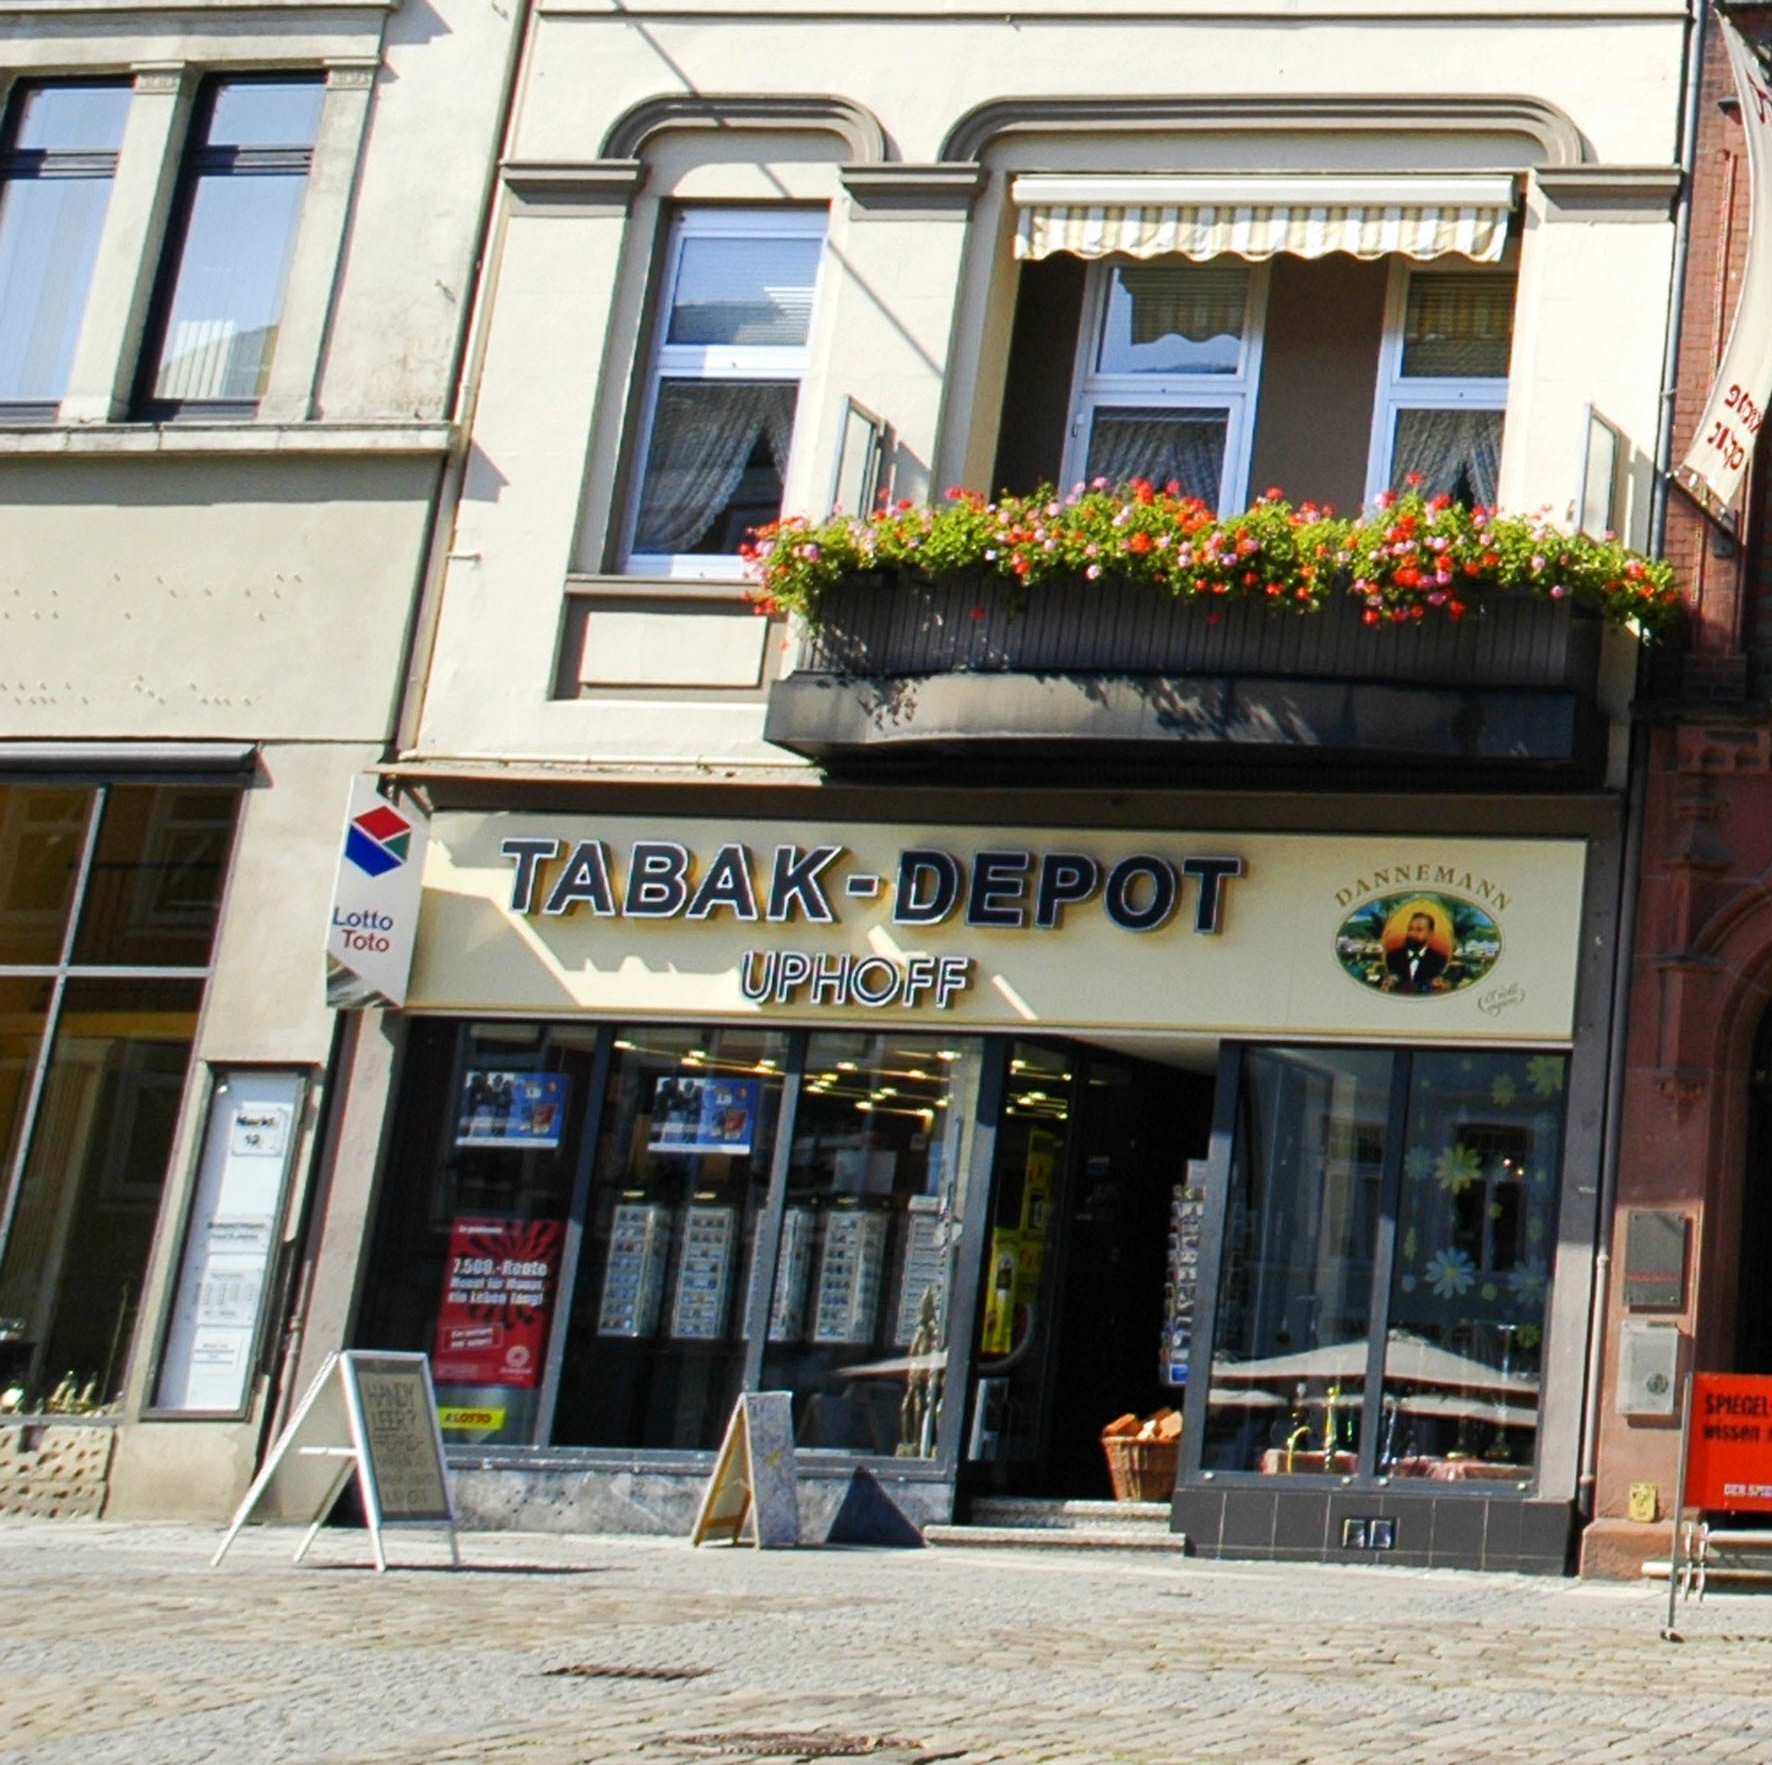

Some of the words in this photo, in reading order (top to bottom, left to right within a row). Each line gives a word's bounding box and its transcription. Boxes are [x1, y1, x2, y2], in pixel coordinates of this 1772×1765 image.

[1334, 864, 1513, 912] DANNEMANN
[333, 906, 394, 931] Lotto
[342, 929, 390, 952] Toto
[740, 950, 969, 1009] UPHOFF
[1703, 1421, 1759, 1442] wissen
